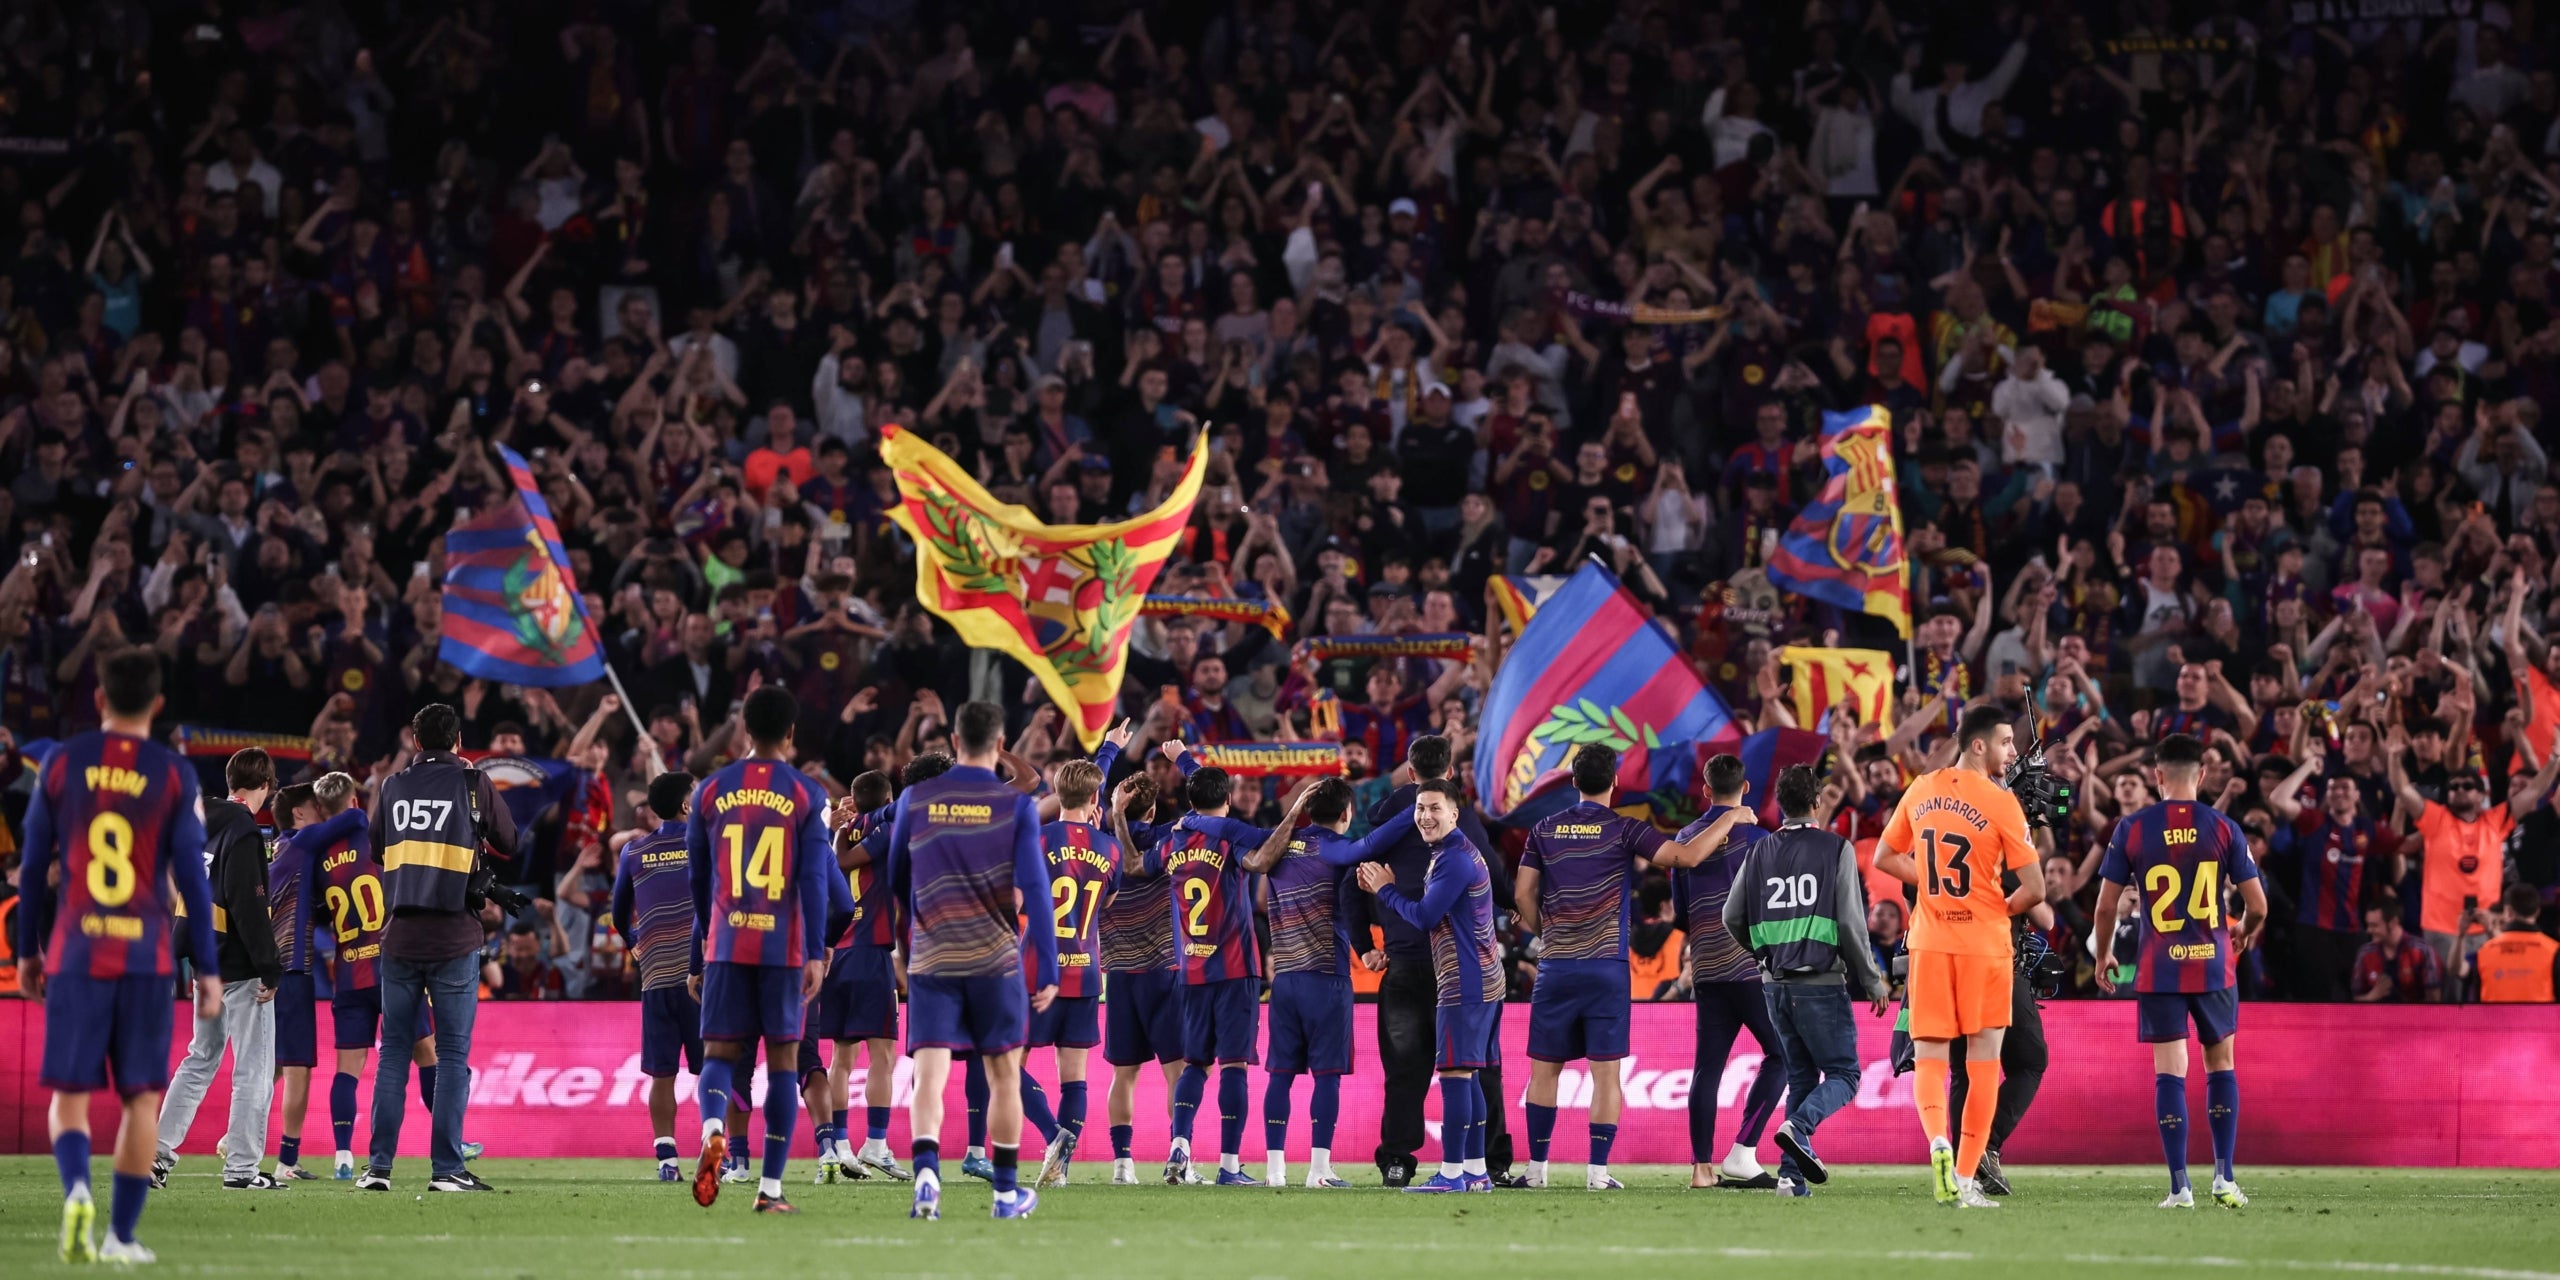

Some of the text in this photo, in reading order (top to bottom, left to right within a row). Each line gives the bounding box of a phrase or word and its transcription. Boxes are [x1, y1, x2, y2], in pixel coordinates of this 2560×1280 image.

[85, 765, 149, 799] PEDRI
[392, 799, 453, 832] 057
[715, 789, 795, 817] RASHFORD
[950, 804, 992, 817] CONGO
[1914, 797, 1989, 832] JOAN GARCIA
[1570, 825, 1602, 835] CONGO
[2163, 827, 2198, 846] ERIC
[86, 811, 136, 908] 8
[322, 849, 358, 872] OLMO
[721, 823, 785, 900] 14
[1047, 846, 1111, 874] F. DE JONG
[1187, 848, 1224, 870] CANCEL
[1920, 828, 1972, 897] 13
[1183, 877, 1211, 937] 2
[1766, 873, 1818, 909] 210
[2144, 860, 2219, 933] 24
[324, 874, 386, 944] 20
[1051, 876, 1103, 940] 21
[2187, 943, 2215, 951] UNHCR
[2188, 950, 2215, 958] ACNUR
